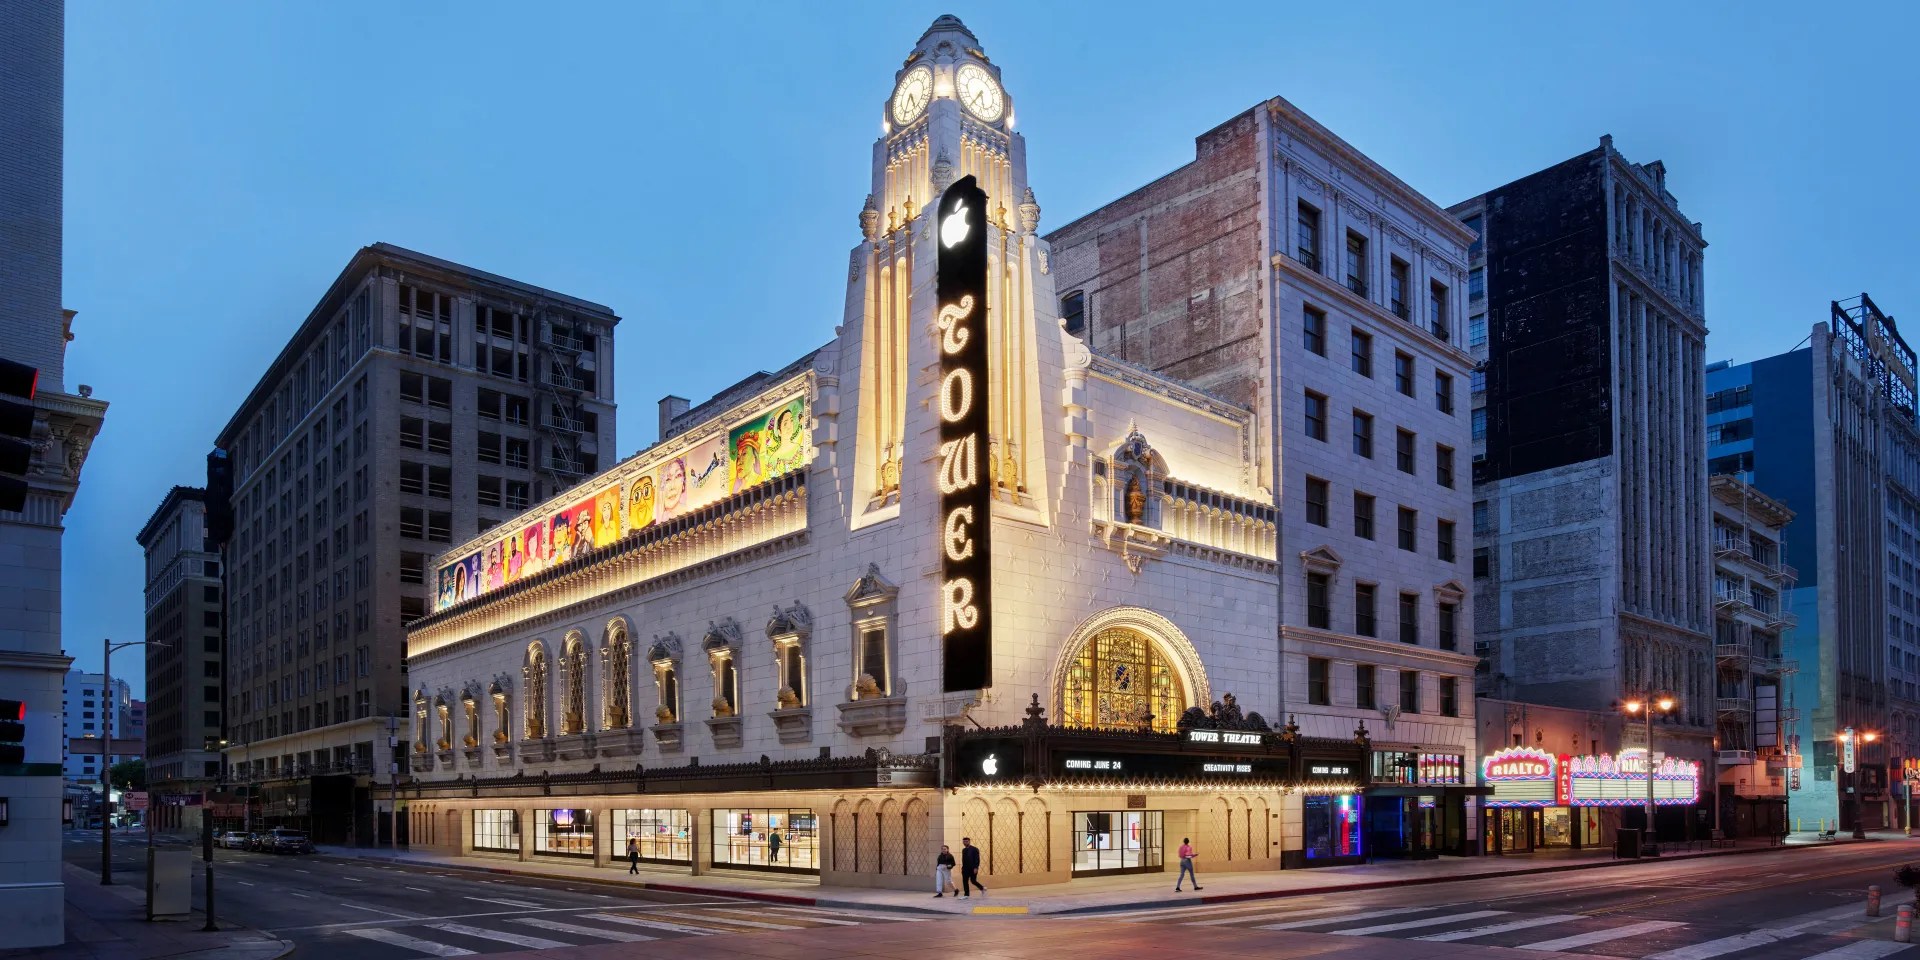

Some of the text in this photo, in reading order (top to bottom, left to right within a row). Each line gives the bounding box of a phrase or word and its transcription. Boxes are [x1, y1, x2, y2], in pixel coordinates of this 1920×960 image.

[938, 294, 978, 636] TOWER
[1190, 731, 1261, 744] TOWER THEATRE
[1066, 759, 1121, 770] COMING JUNE 24
[1203, 763, 1252, 773] CREATIVITY RISES
[1491, 762, 1545, 776] RIALTO
[1561, 760, 1569, 801] RIALTO
